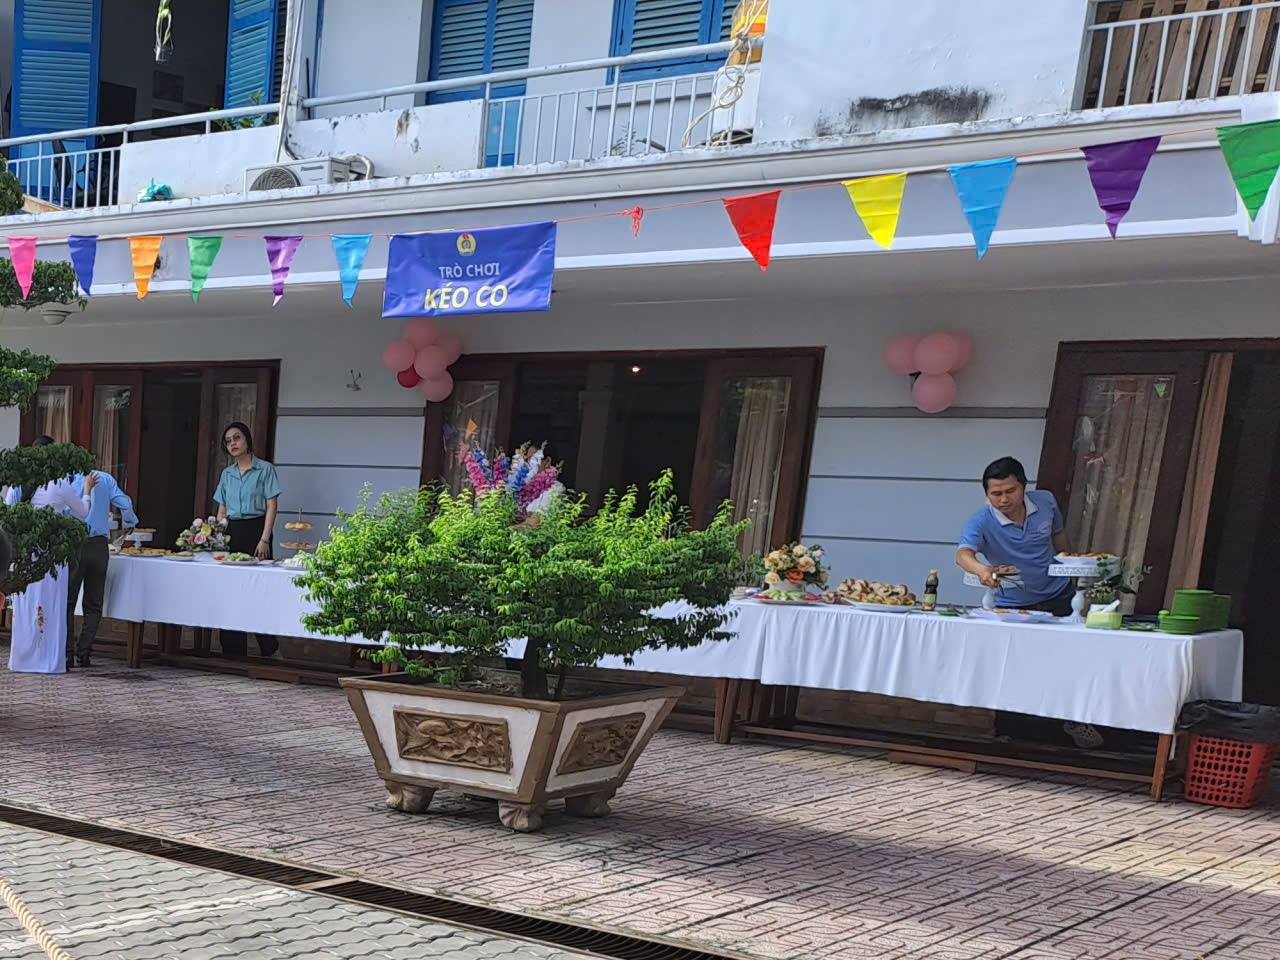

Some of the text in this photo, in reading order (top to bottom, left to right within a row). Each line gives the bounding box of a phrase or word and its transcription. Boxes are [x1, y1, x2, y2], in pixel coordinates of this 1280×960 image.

[438, 262, 500, 278] TRÒ CHƠI
[424, 281, 508, 310] KÉO CO
